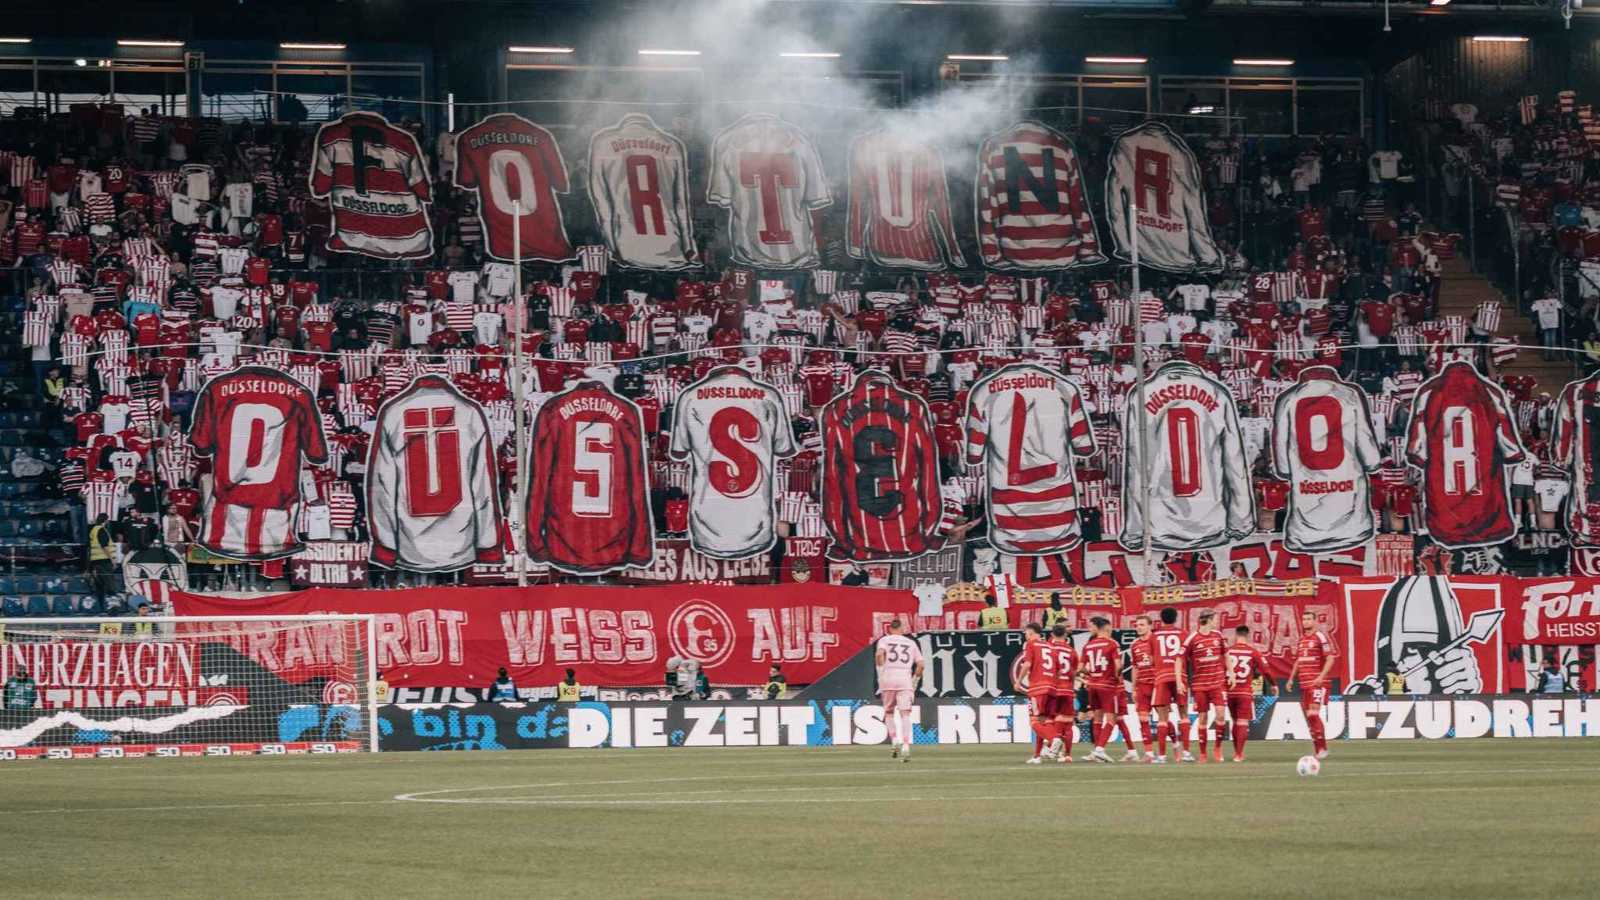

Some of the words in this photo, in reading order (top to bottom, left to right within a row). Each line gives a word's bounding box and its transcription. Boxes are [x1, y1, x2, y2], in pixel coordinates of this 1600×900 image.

[1003, 145, 1060, 215] N
[739, 151, 800, 245] T
[735, 272, 747, 286] 13
[1255, 277, 1270, 289] 28
[1143, 381, 1221, 416] DÜSSELDORF
[1007, 390, 1058, 486] L
[117, 457, 133, 470] 14
[708, 406, 762, 499] S
[571, 421, 614, 518] S
[681, 548, 719, 581] AUS
[374, 608, 467, 666] ROT
[500, 606, 659, 667] WEISS
[747, 605, 840, 664] AUF
[936, 632, 1046, 647] ULTR
[1157, 635, 1181, 657] 19
[888, 643, 911, 664] 33
[1041, 648, 1053, 670] 5
[1058, 652, 1071, 674] 5
[1087, 649, 1109, 673] 14
[563, 688, 577, 697] K9
[568, 707, 667, 748] DIE
[684, 706, 815, 746] ZEIT
[937, 704, 1066, 744] REI
